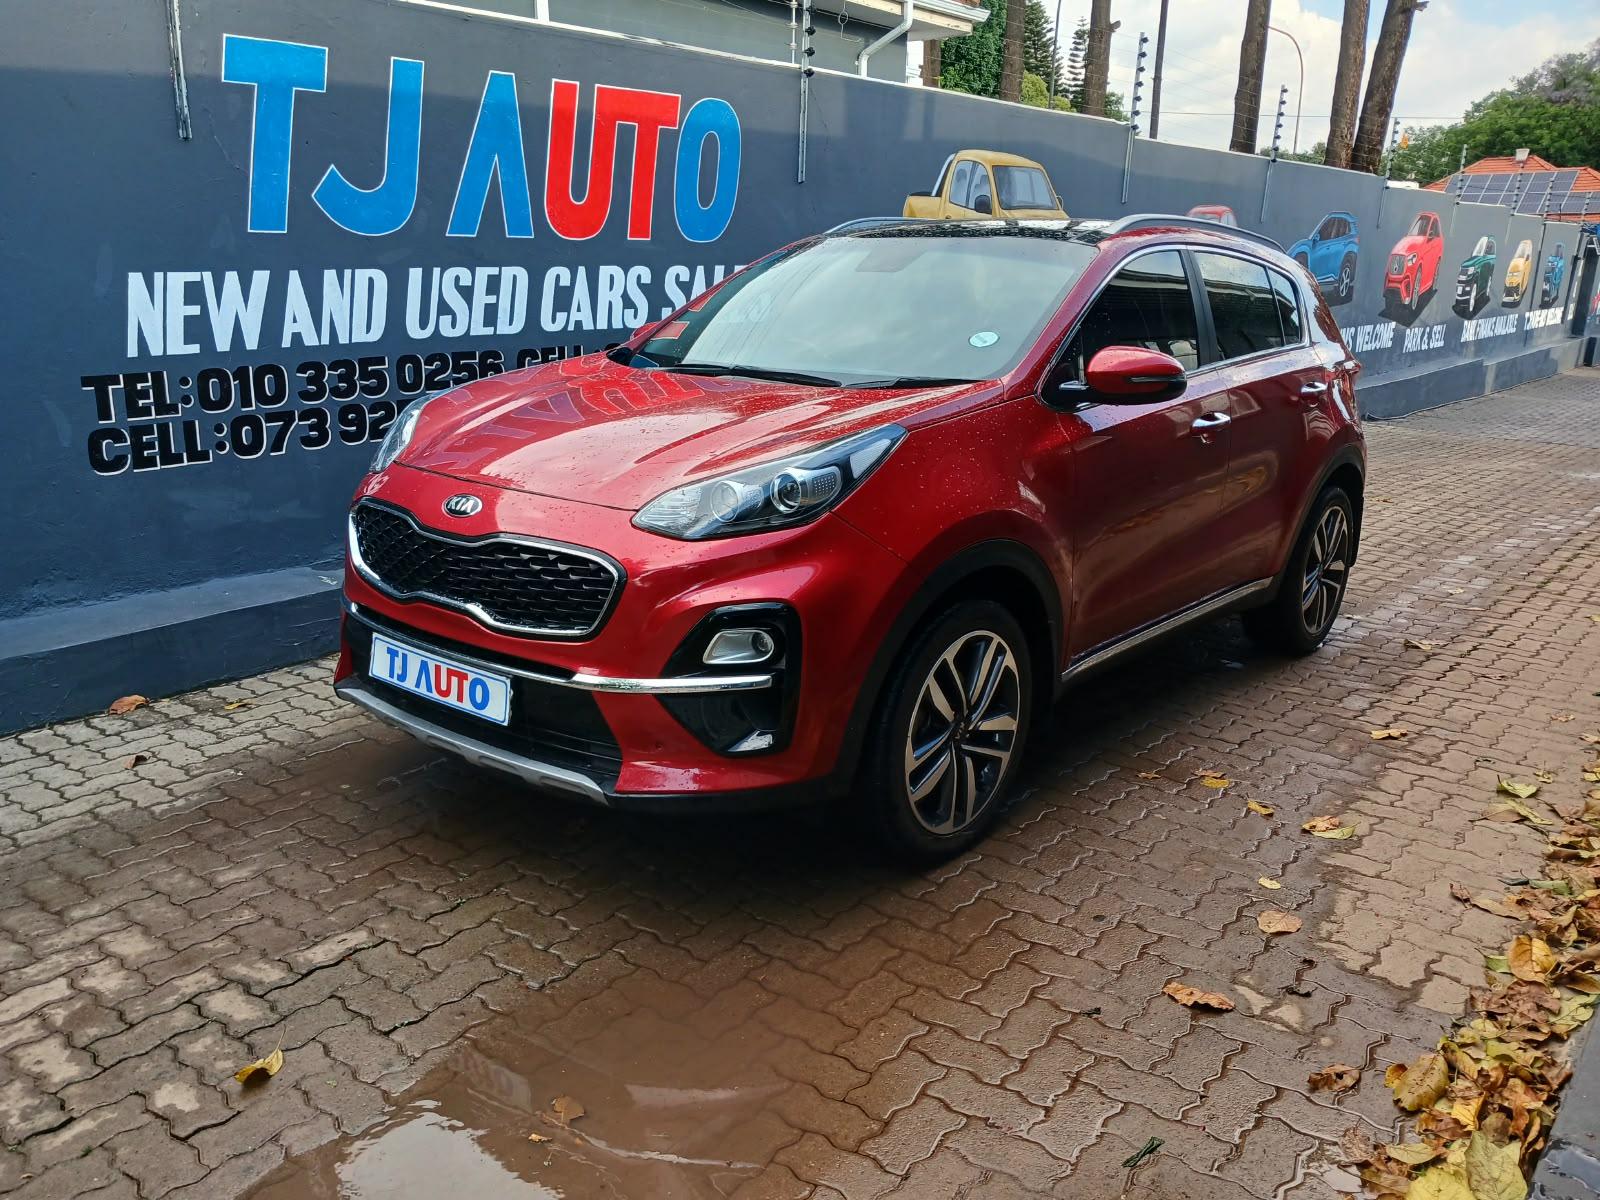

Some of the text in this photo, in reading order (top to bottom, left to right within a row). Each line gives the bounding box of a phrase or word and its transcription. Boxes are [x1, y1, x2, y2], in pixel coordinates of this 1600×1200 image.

[222, 33, 742, 242] TJ AUTO
[127, 269, 270, 358] NEW
[281, 268, 388, 348] AND
[406, 266, 529, 339] USED
[540, 265, 652, 332] CARS
[1356, 321, 1396, 353] WELCOME
[1403, 324, 1447, 353] PARK & SELL
[296, 355, 390, 404] 335
[396, 350, 506, 394] 0256
[338, 398, 418, 446] 92
[447, 496, 475, 513] KIA
[386, 646, 490, 711] TJ AUTO
